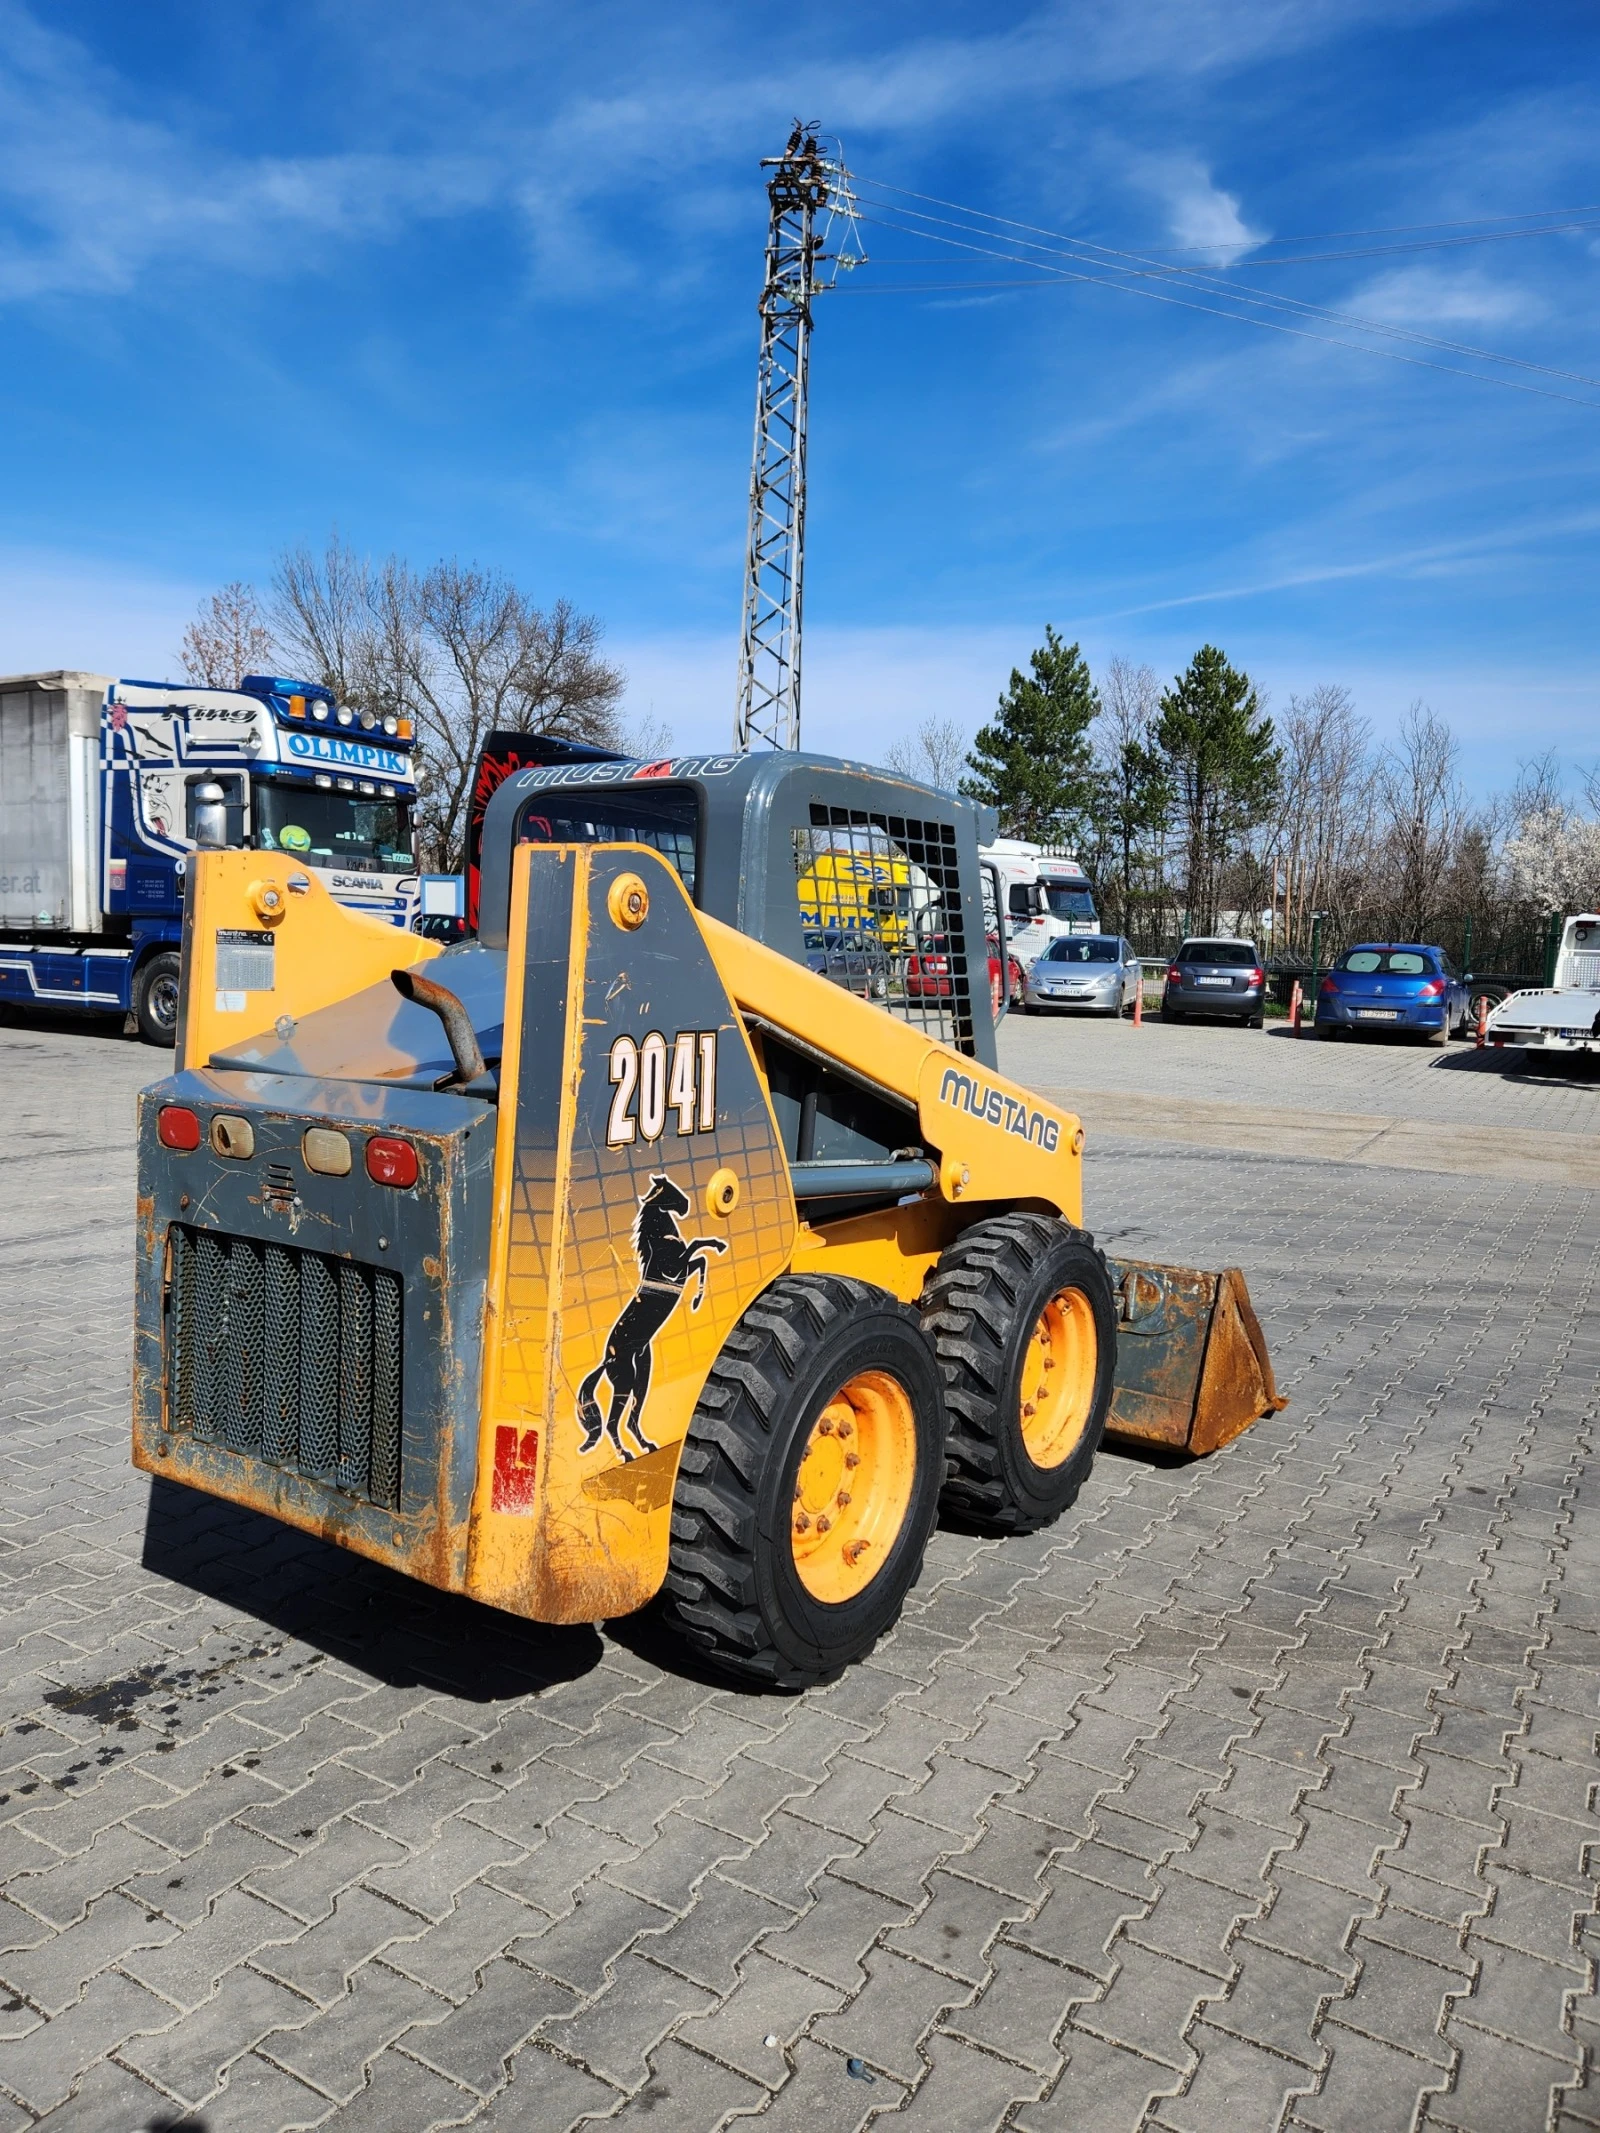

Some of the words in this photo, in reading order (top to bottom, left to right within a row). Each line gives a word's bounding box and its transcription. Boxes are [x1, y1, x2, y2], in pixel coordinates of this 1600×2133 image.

[161, 704, 258, 724] King
[288, 734, 403, 772] OLIMPIK
[332, 875, 384, 891] SCANIA
[606, 1029, 718, 1147] 2041
[939, 1067, 1060, 1153] MUSTANG
